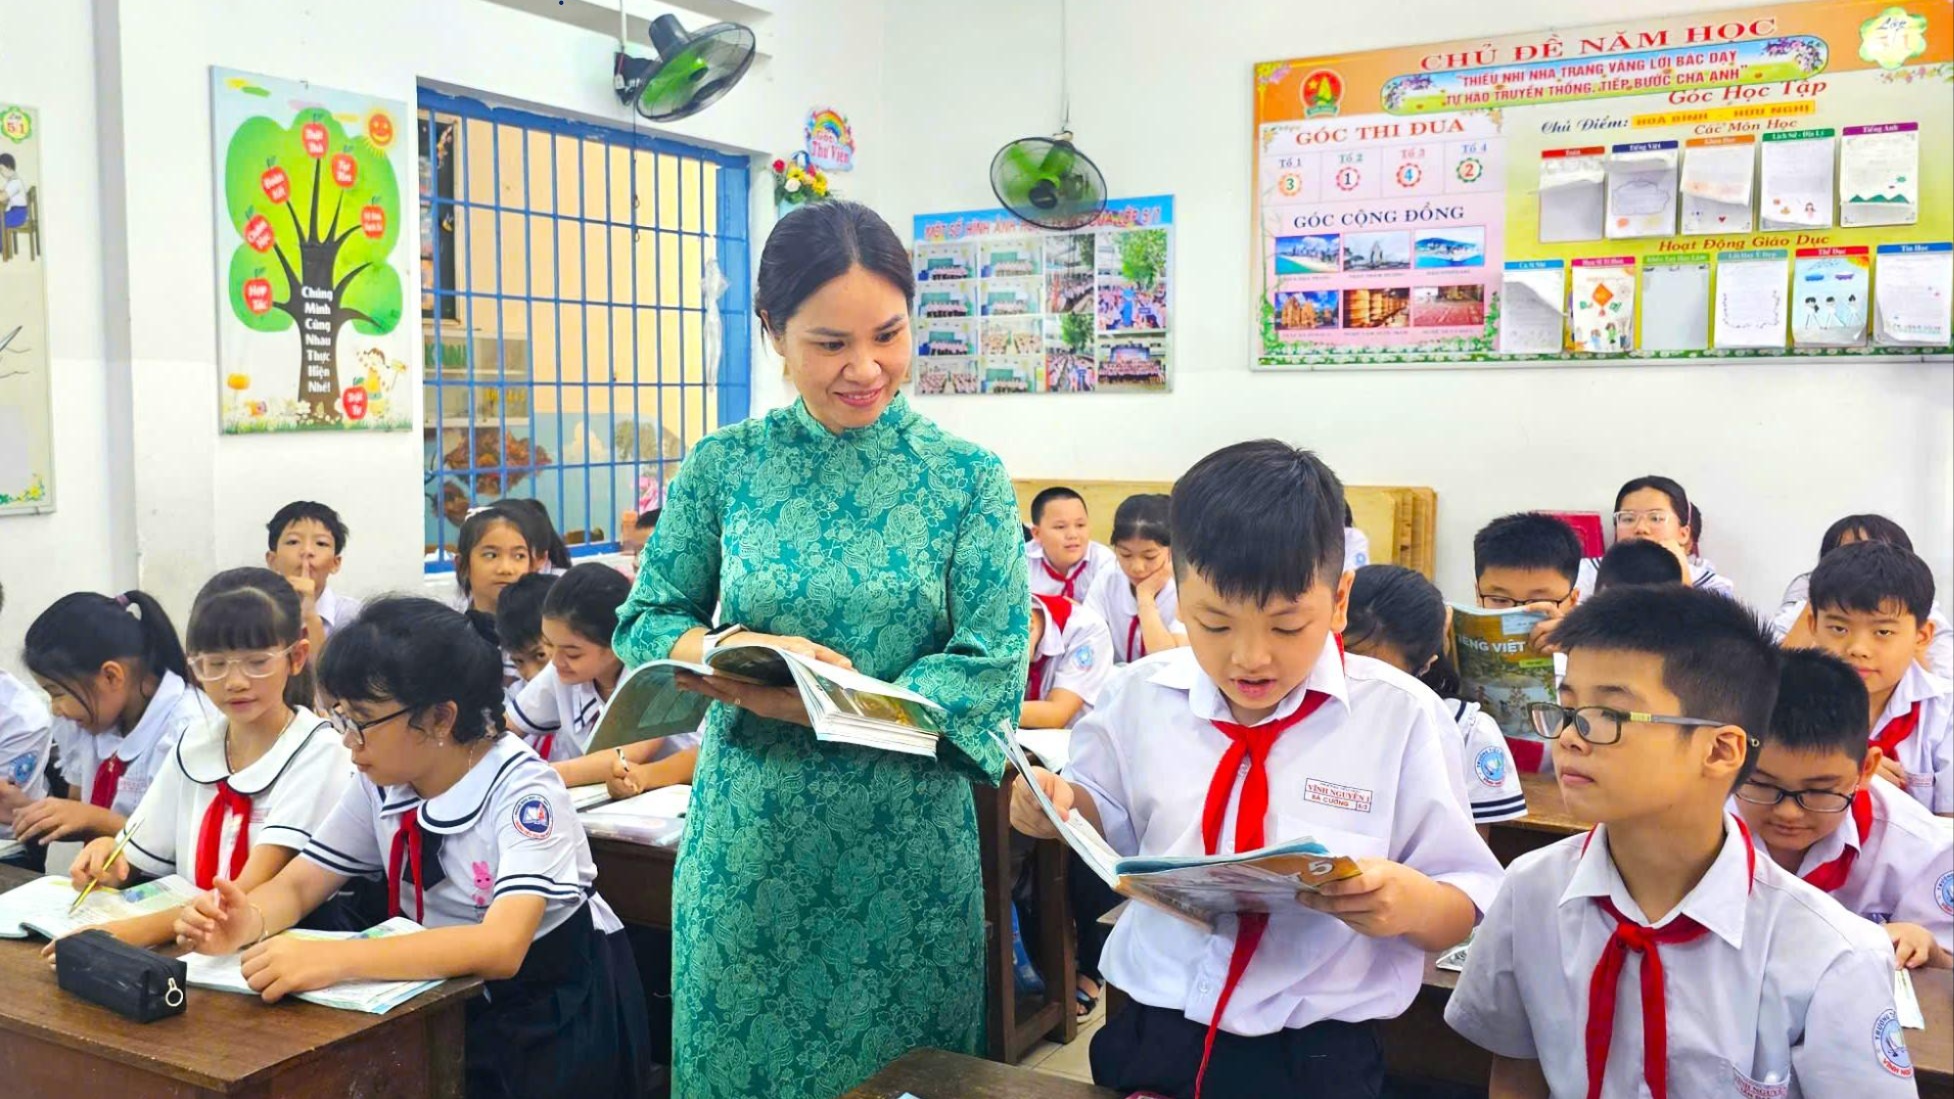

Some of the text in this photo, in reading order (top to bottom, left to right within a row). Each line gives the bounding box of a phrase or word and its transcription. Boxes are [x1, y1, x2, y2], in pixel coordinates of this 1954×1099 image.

[1420, 19, 1775, 71] CHỦ ĐỀ NĂM HỌC
[1502, 70, 1524, 84] NHI
[1529, 68, 1556, 81] NHA
[1561, 63, 1604, 78] TRANG
[1676, 70, 1705, 85] CHA
[1668, 80, 1827, 105] Góc Học Tập
[1296, 118, 1465, 146] GÓC THI ĐUA
[1694, 117, 1798, 135] Các Môn Học
[1404, 168, 1413, 181] 4
[1464, 163, 1474, 177] 2
[1286, 178, 1295, 191] 3
[1344, 172, 1351, 185] 1
[1294, 211, 1337, 229] GÓC
[1341, 208, 1397, 228] CỘNG
[1659, 235, 1830, 252] Hoạt Động Giáo Dục
[301, 286, 333, 301] Chúng
[304, 302, 331, 315] Mình
[305, 318, 331, 332] Cùng
[305, 333, 331, 346] Nhau
[306, 349, 331, 364] Thực
[308, 365, 330, 379] Hiện
[308, 381, 331, 393] Nhé!
[1491, 639, 1526, 655] VIỆT
[1308, 859, 1334, 875] 5
